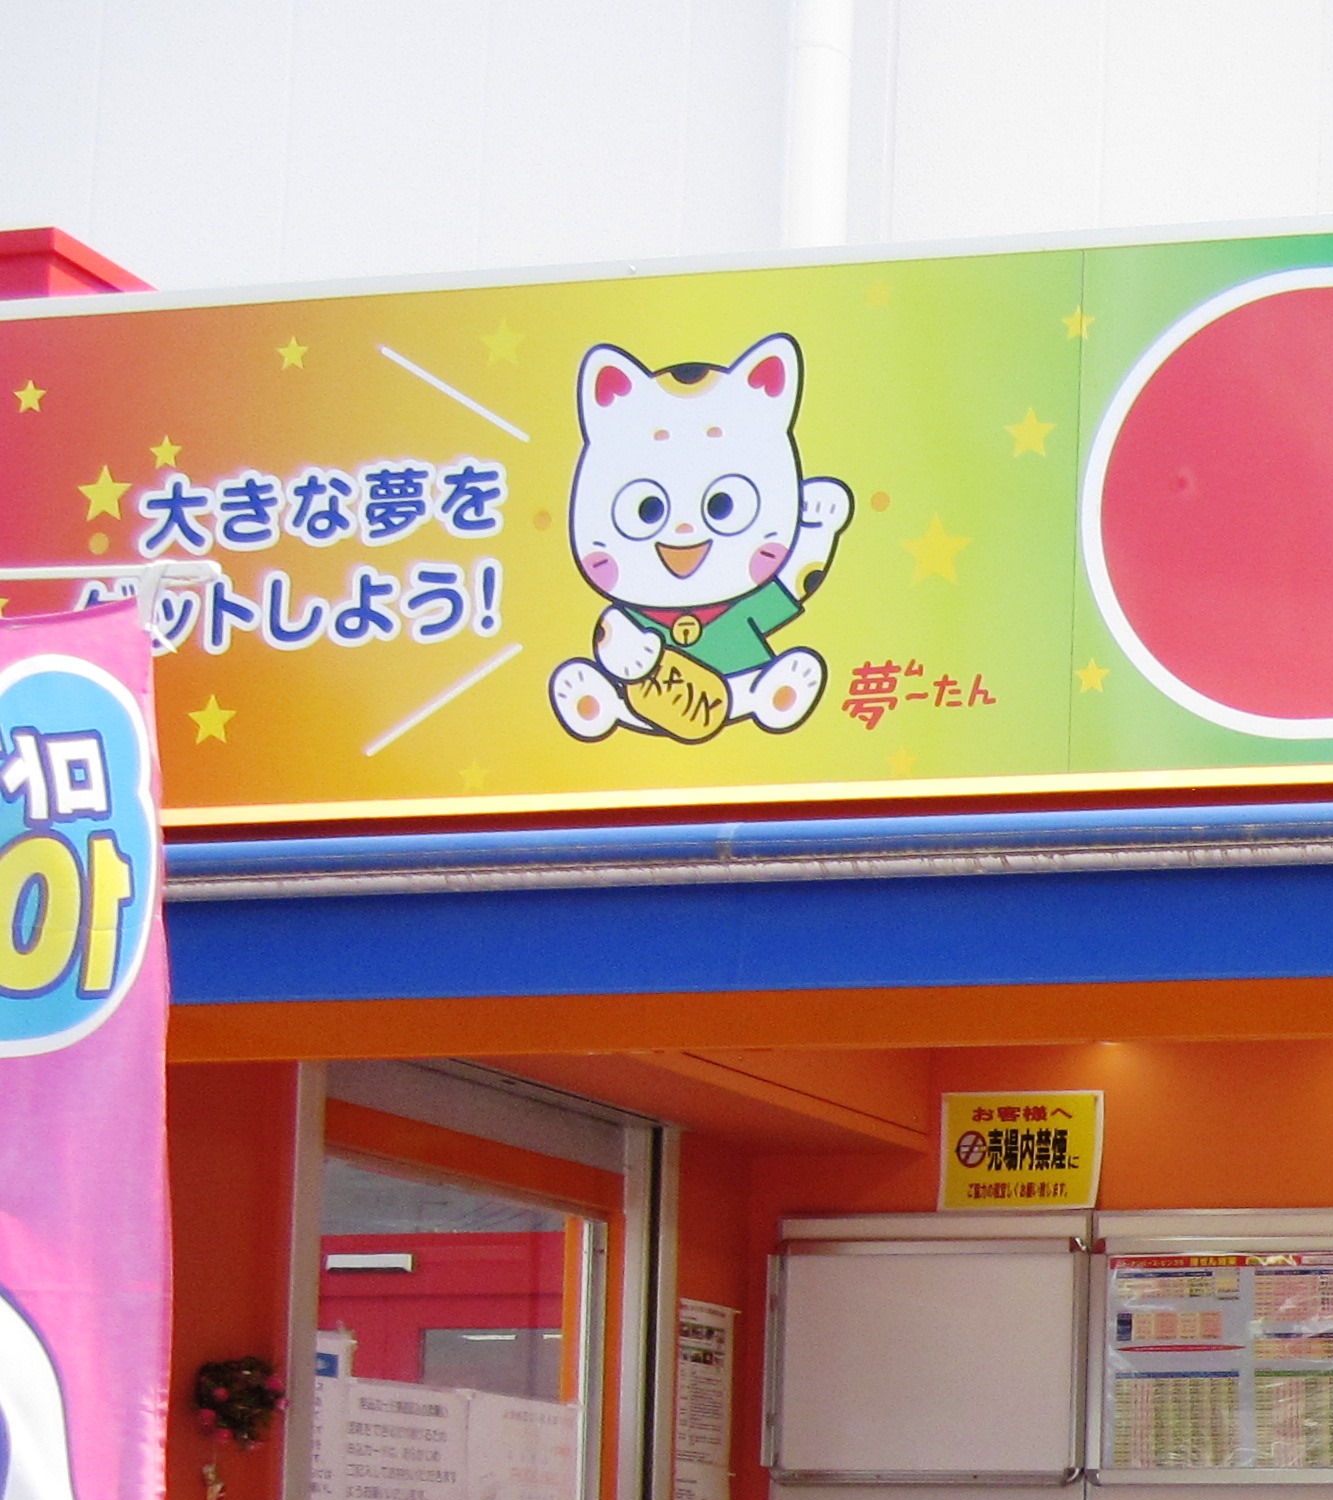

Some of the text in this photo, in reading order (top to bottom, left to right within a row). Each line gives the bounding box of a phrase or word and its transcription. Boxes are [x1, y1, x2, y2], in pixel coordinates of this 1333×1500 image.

[145, 466, 501, 553] 大きな夢を
[972, 1106, 1072, 1122] お客様へ
